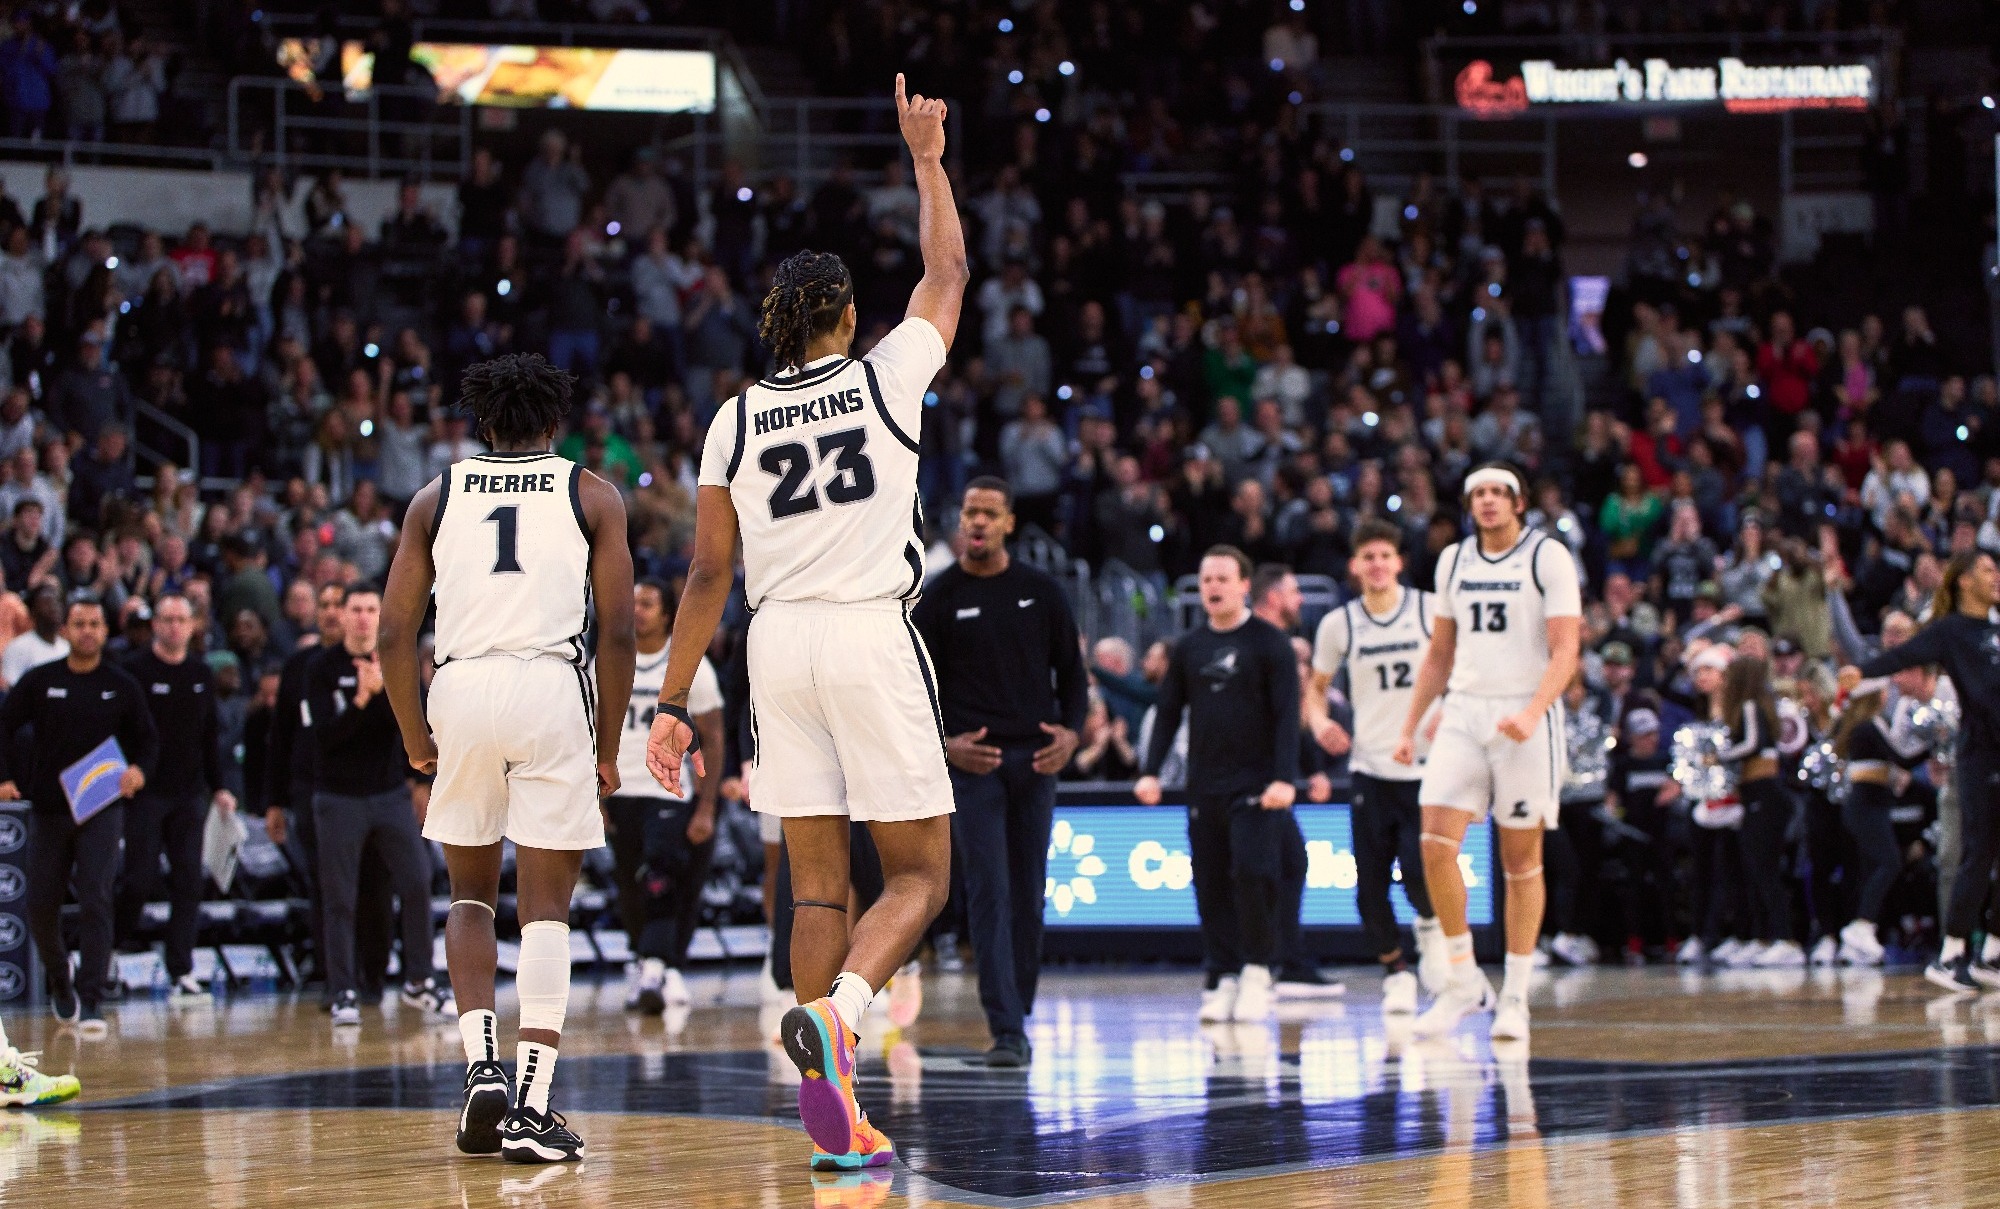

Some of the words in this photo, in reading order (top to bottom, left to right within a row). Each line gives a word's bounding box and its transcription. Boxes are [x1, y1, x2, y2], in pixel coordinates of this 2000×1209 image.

[754, 387, 864, 436] HOPKINS
[463, 473, 555, 493] PIERRE
[757, 425, 878, 522] 23
[480, 504, 526, 575] 1
[1470, 602, 1507, 633] 13
[1376, 661, 1413, 691] 12
